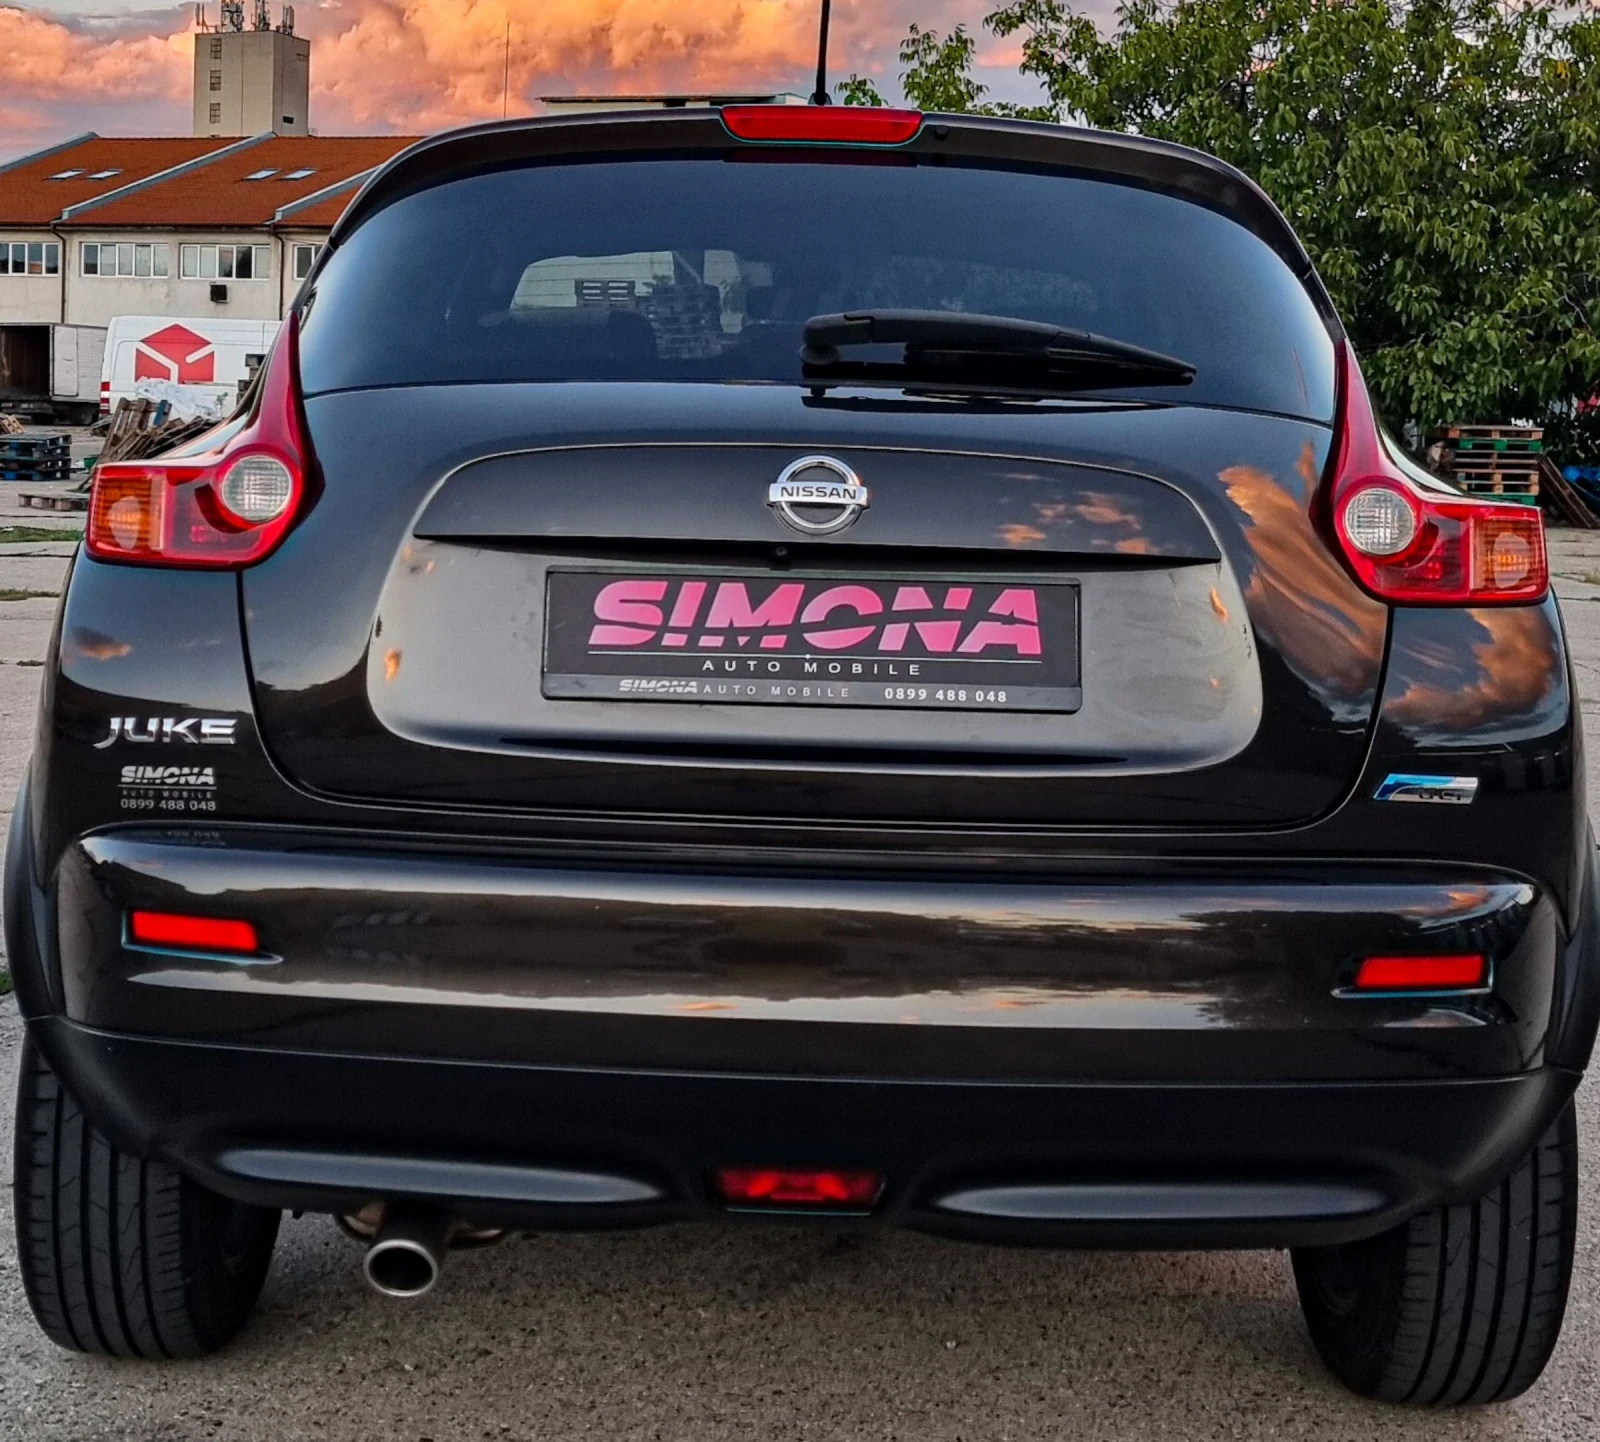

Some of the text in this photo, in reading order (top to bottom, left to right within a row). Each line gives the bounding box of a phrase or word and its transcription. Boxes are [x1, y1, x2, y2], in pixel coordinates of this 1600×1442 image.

[780, 486, 857, 500] NISSAN
[587, 580, 1042, 655] SIMONA
[702, 660, 920, 676] AUTO MOBILE
[619, 679, 1007, 703] SIMONA AUTO MOBILE 0899 488 048
[93, 717, 238, 750] JUKE
[120, 765, 215, 785] SIMONA
[121, 790, 213, 799] AUTO MOBILE
[120, 799, 217, 811] 0899 488 048
